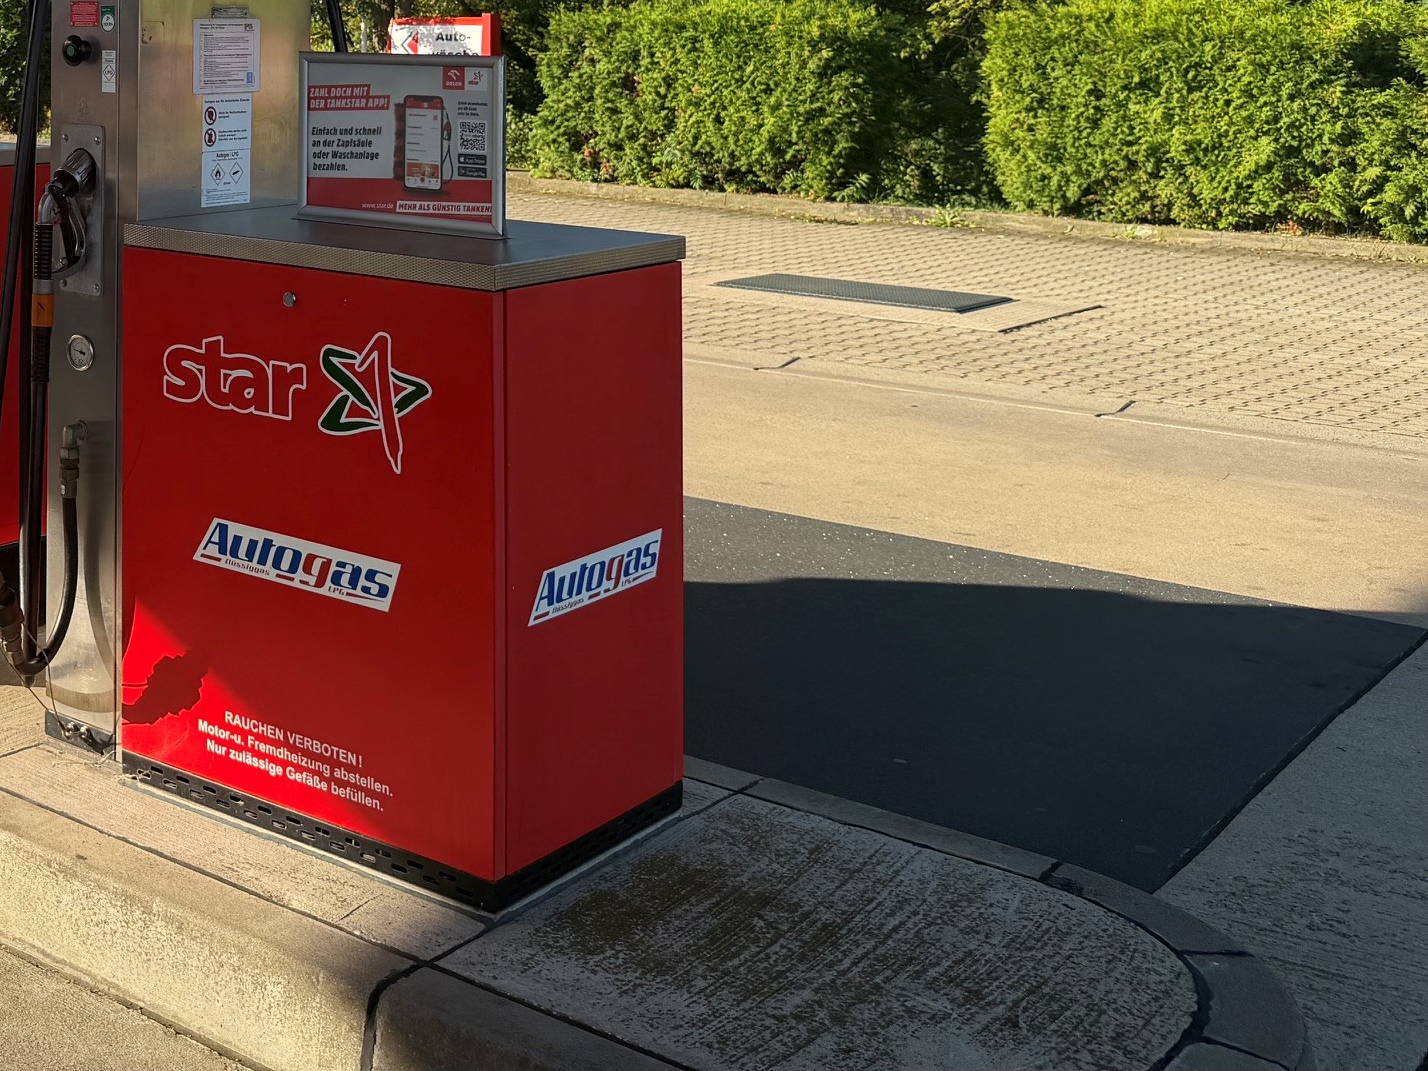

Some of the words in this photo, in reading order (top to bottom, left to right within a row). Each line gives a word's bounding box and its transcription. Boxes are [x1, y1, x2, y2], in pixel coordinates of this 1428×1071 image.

[435, 33, 471, 42] Auto-
[309, 88, 329, 97] ZAHL
[330, 87, 352, 97] DOCH
[352, 86, 368, 96] MIT
[310, 99, 325, 108] DER
[326, 98, 367, 108] TANKSTAR
[367, 98, 388, 107] APP!
[311, 126, 338, 136] Einfach
[339, 126, 353, 136] und
[354, 126, 382, 136] schnell
[311, 140, 321, 148] an
[322, 139, 335, 148] der
[336, 138, 373, 148] Zapfsäule
[312, 150, 330, 159] oder
[331, 150, 380, 161] Waschanlage
[312, 162, 348, 171] bezahlen.
[398, 203, 417, 211] MEHR
[432, 203, 461, 212] GÜNSTIG
[163, 335, 306, 420] star
[202, 522, 393, 599] Autogas
[535, 539, 659, 612] Autogas
[225, 710, 284, 741] RAUCHEN
[198, 719, 245, 746] Motor-u.
[247, 736, 331, 777] Fremdheizung
[333, 766, 394, 796] abstellen.
[206, 739, 227, 756] Nur
[229, 747, 283, 777] zulässige
[286, 766, 328, 791] Gefäße
[331, 782, 384, 811] befüllen.
